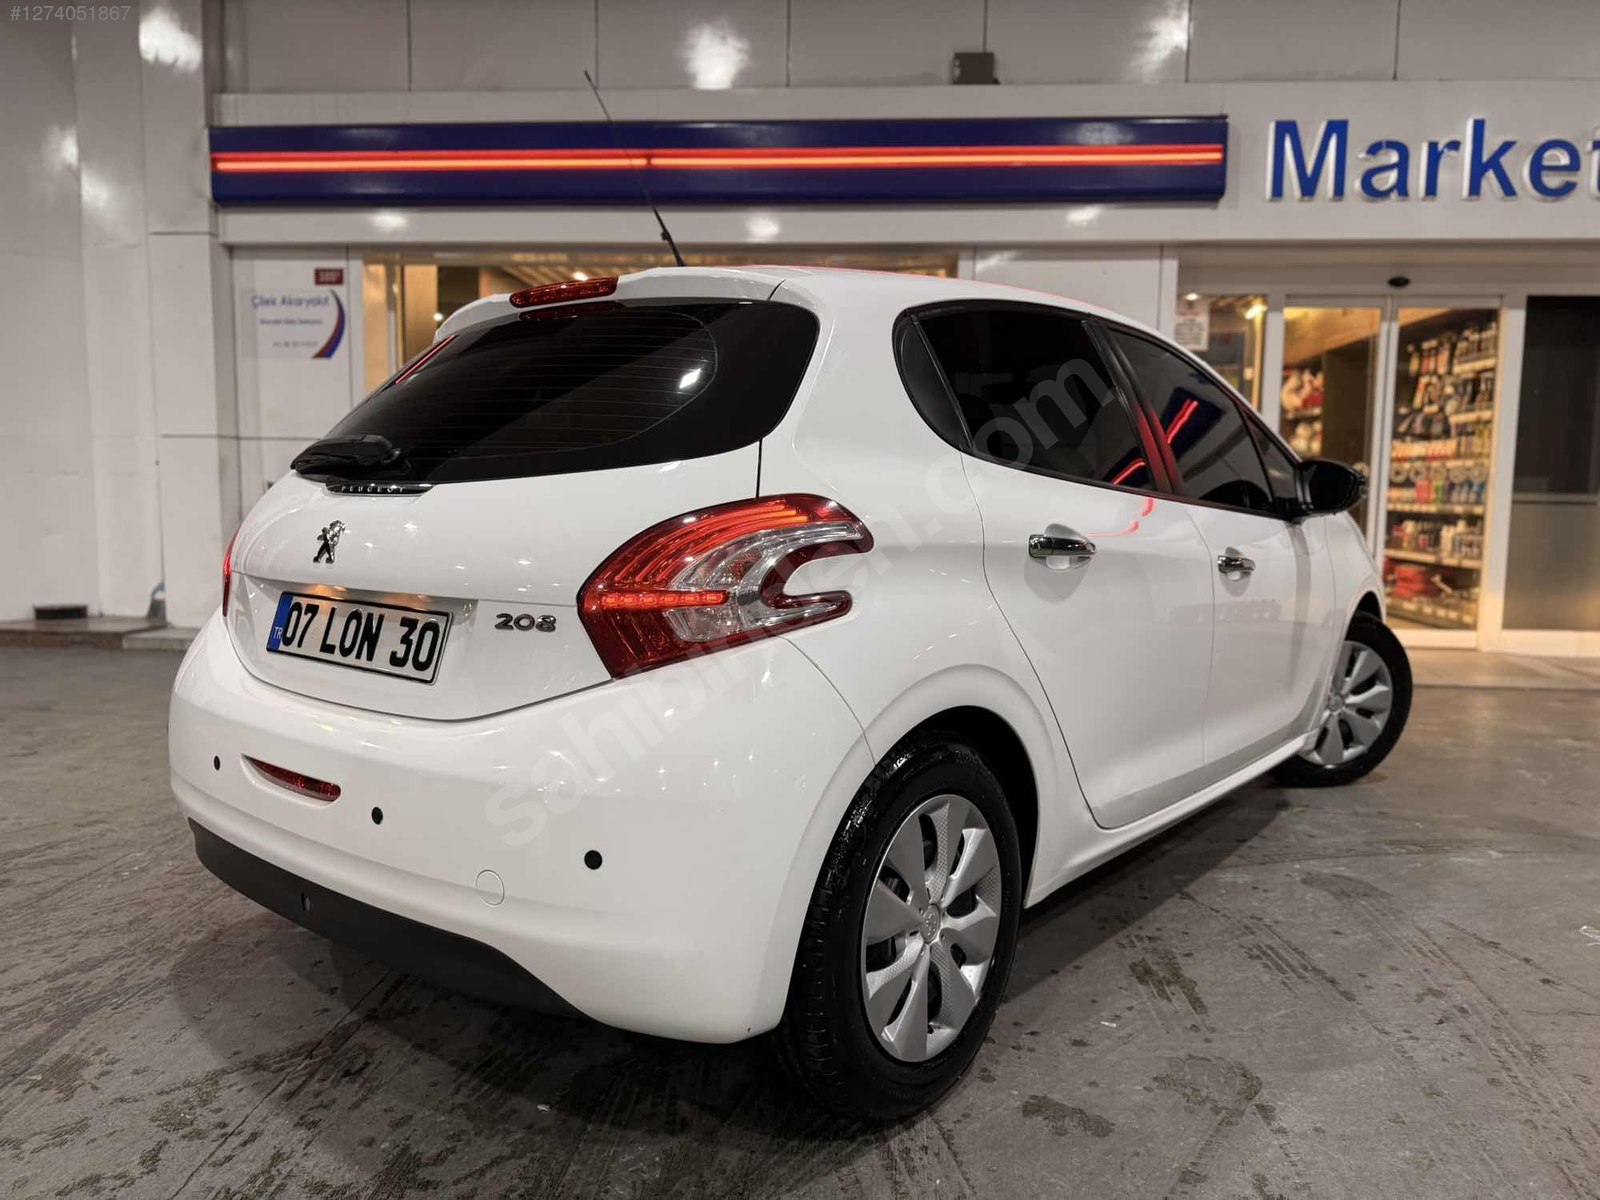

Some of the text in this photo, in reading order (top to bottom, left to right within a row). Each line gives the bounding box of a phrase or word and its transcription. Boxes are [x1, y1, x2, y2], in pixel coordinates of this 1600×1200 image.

[341, 484, 406, 493] PEUGEOT
[494, 613, 557, 632] 208
[273, 626, 283, 640] TR
[282, 602, 440, 672] 07 LON 30
